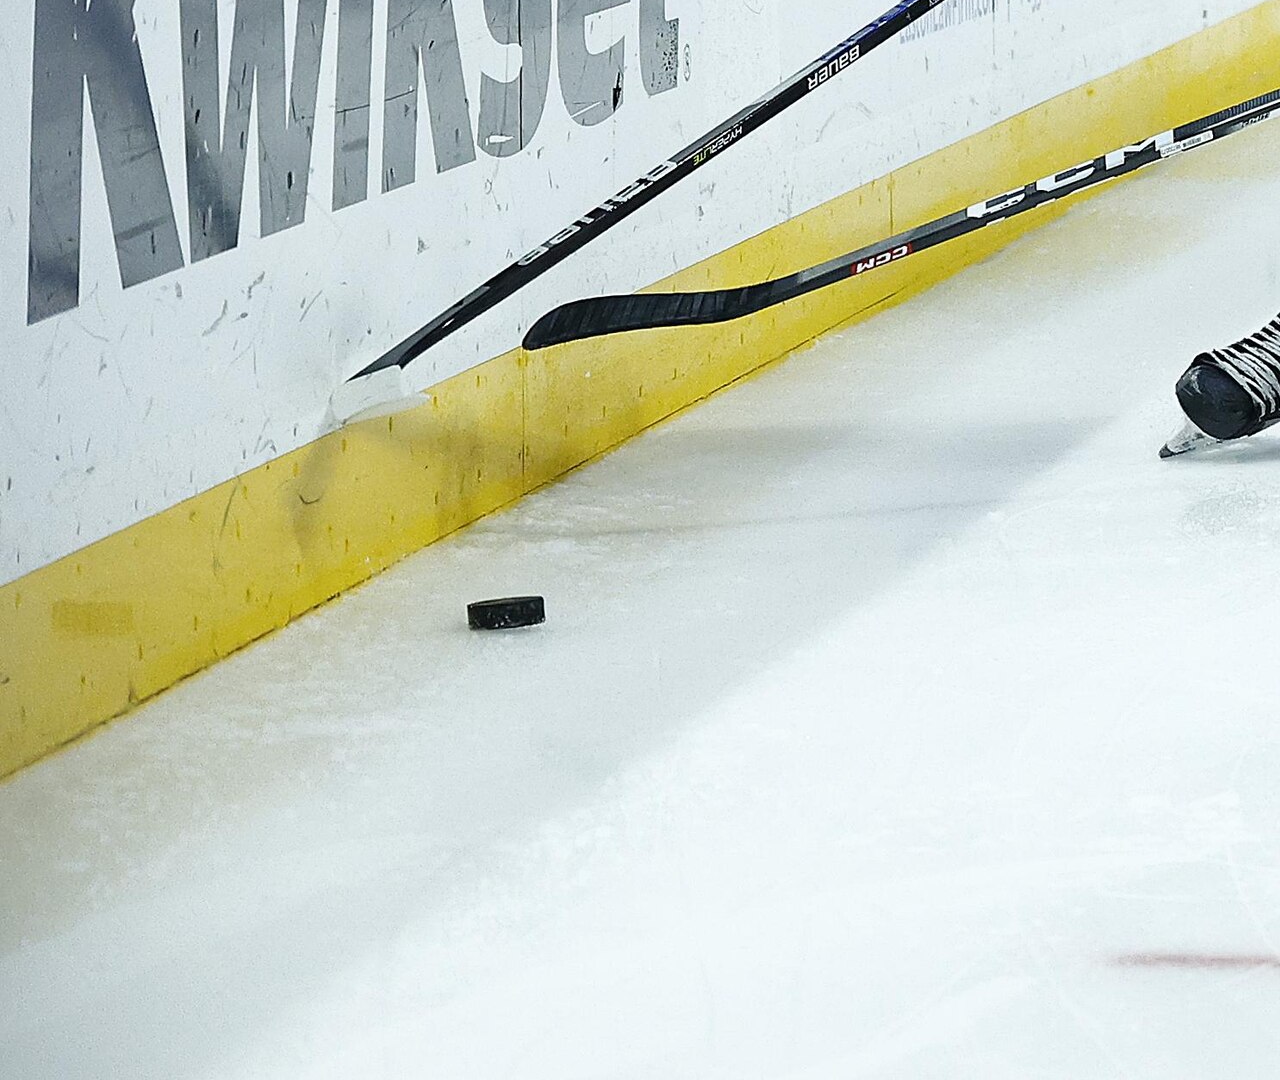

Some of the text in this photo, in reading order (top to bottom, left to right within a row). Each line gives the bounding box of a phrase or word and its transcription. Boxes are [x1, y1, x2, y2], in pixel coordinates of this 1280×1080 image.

[806, 44, 861, 90] BAUER
[692, 124, 744, 166] HYPERLITE
[856, 245, 908, 274] CCM
